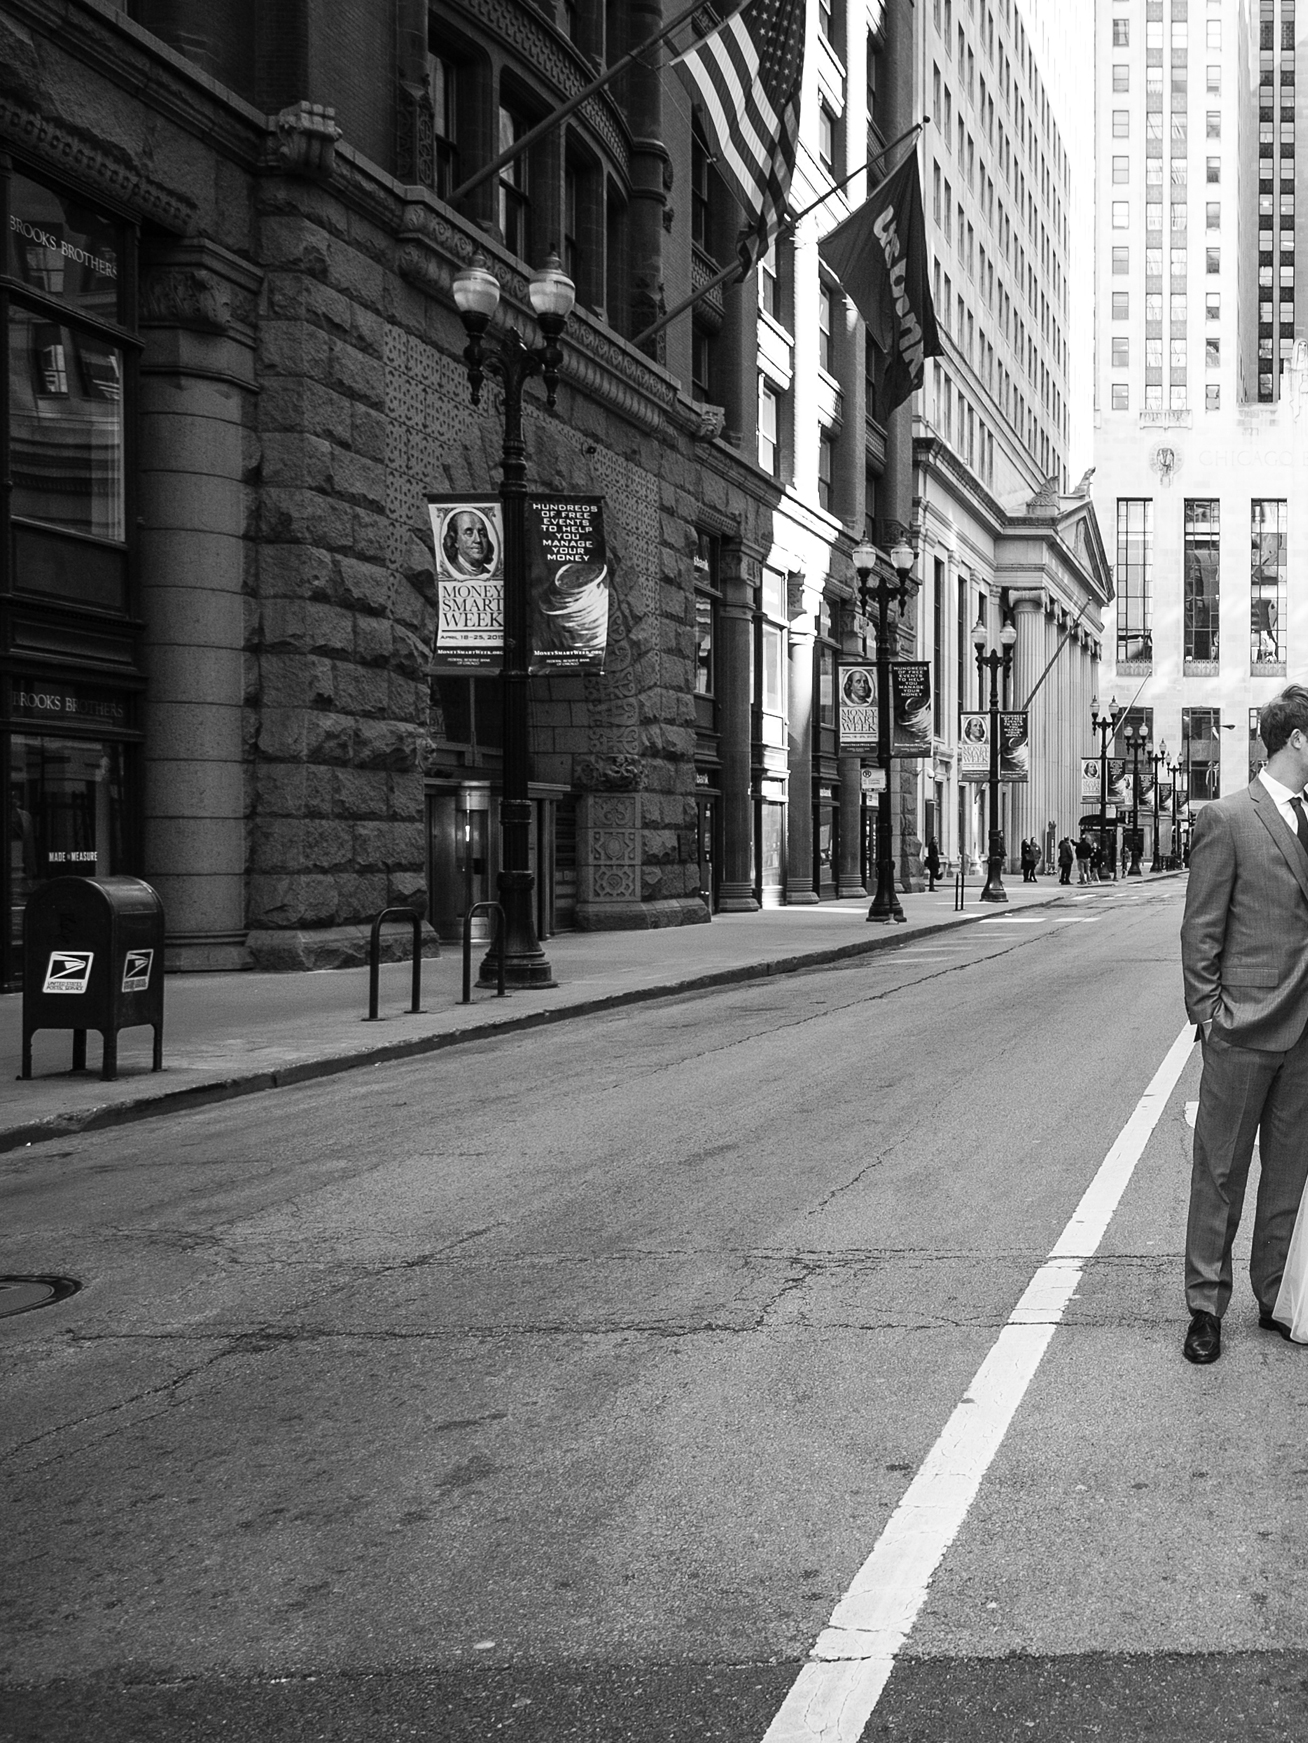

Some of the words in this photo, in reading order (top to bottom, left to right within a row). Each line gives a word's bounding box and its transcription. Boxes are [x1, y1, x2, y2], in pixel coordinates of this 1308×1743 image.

[10, 214, 56, 250] BROOKS
[60, 240, 117, 280] BROTHERS
[1199, 450, 1293, 468] CHICAGO
[533, 503, 598, 512] HUNDREDS
[442, 585, 504, 598] MONEY
[442, 598, 504, 612] SMART
[443, 612, 504, 627] WEEK
[12, 692, 61, 711] BROOKS
[65, 698, 123, 717] BROTHERS
[49, 852, 66, 862] MADE
[71, 852, 98, 861] MEASURE
